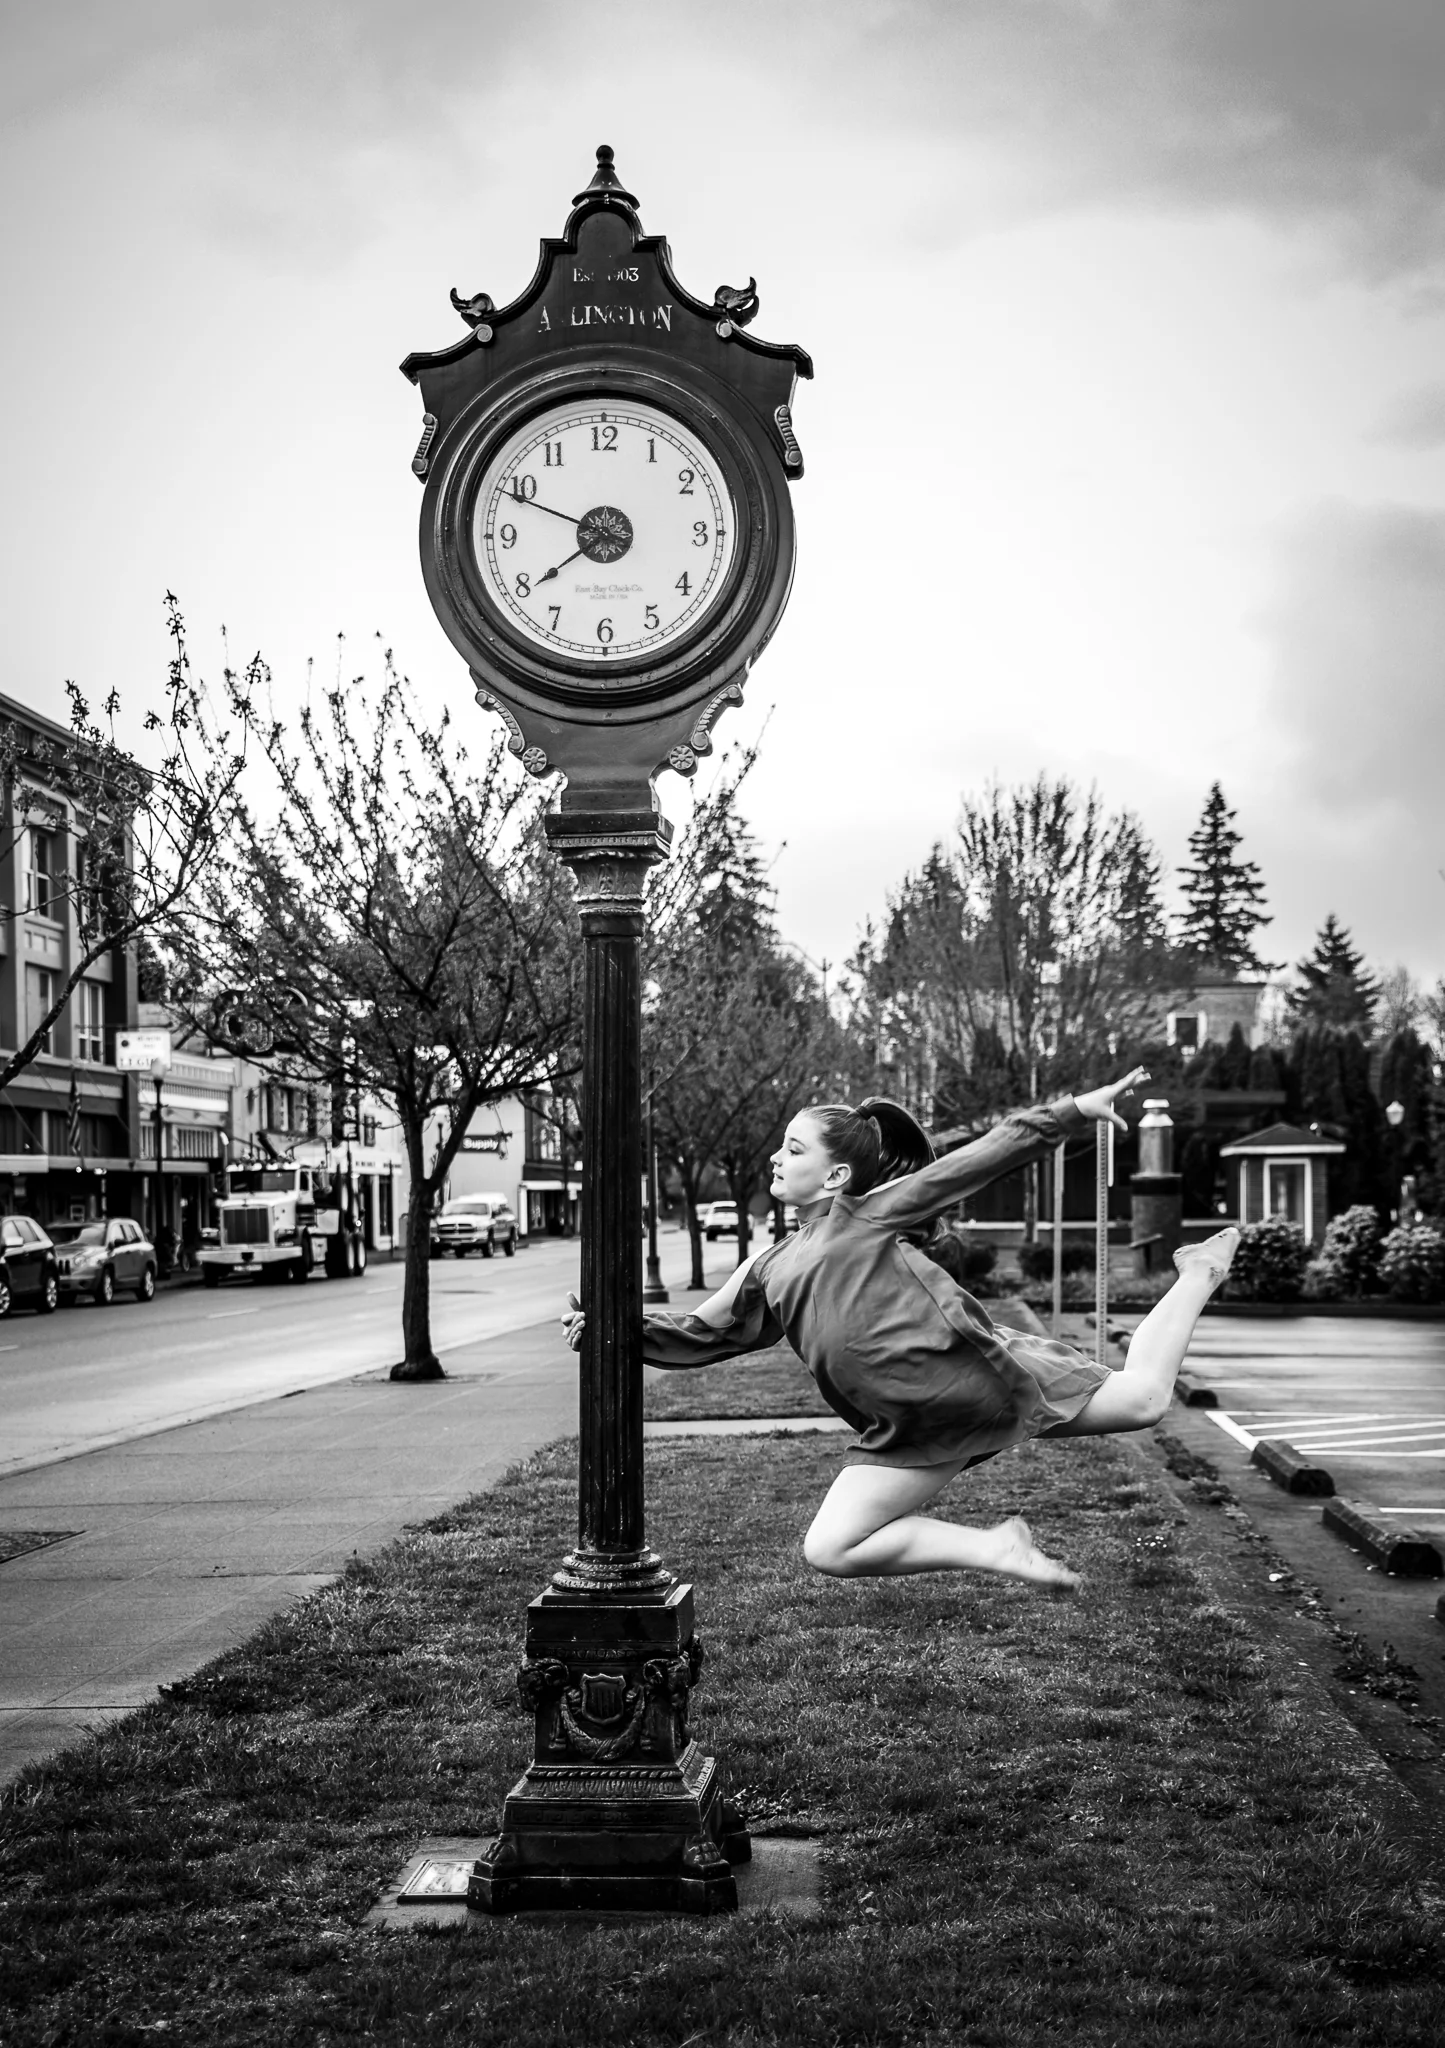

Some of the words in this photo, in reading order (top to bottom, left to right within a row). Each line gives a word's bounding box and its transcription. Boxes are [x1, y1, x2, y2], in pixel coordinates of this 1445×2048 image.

[591, 426, 617, 451] 12
[648, 439, 657, 462] 1
[543, 441, 564, 467] 11
[510, 475, 538, 501] 10
[678, 469, 695, 495] 2
[501, 524, 517, 549] 9
[693, 521, 708, 546] 3
[516, 573, 530, 597] 8
[593, 584, 606, 594] Bay
[608, 584, 630, 593] Clock
[675, 572, 692, 596] 4
[548, 605, 562, 631] 7
[644, 605, 660, 630] 5
[597, 618, 614, 643] 6
[462, 1137, 499, 1151] Supply
